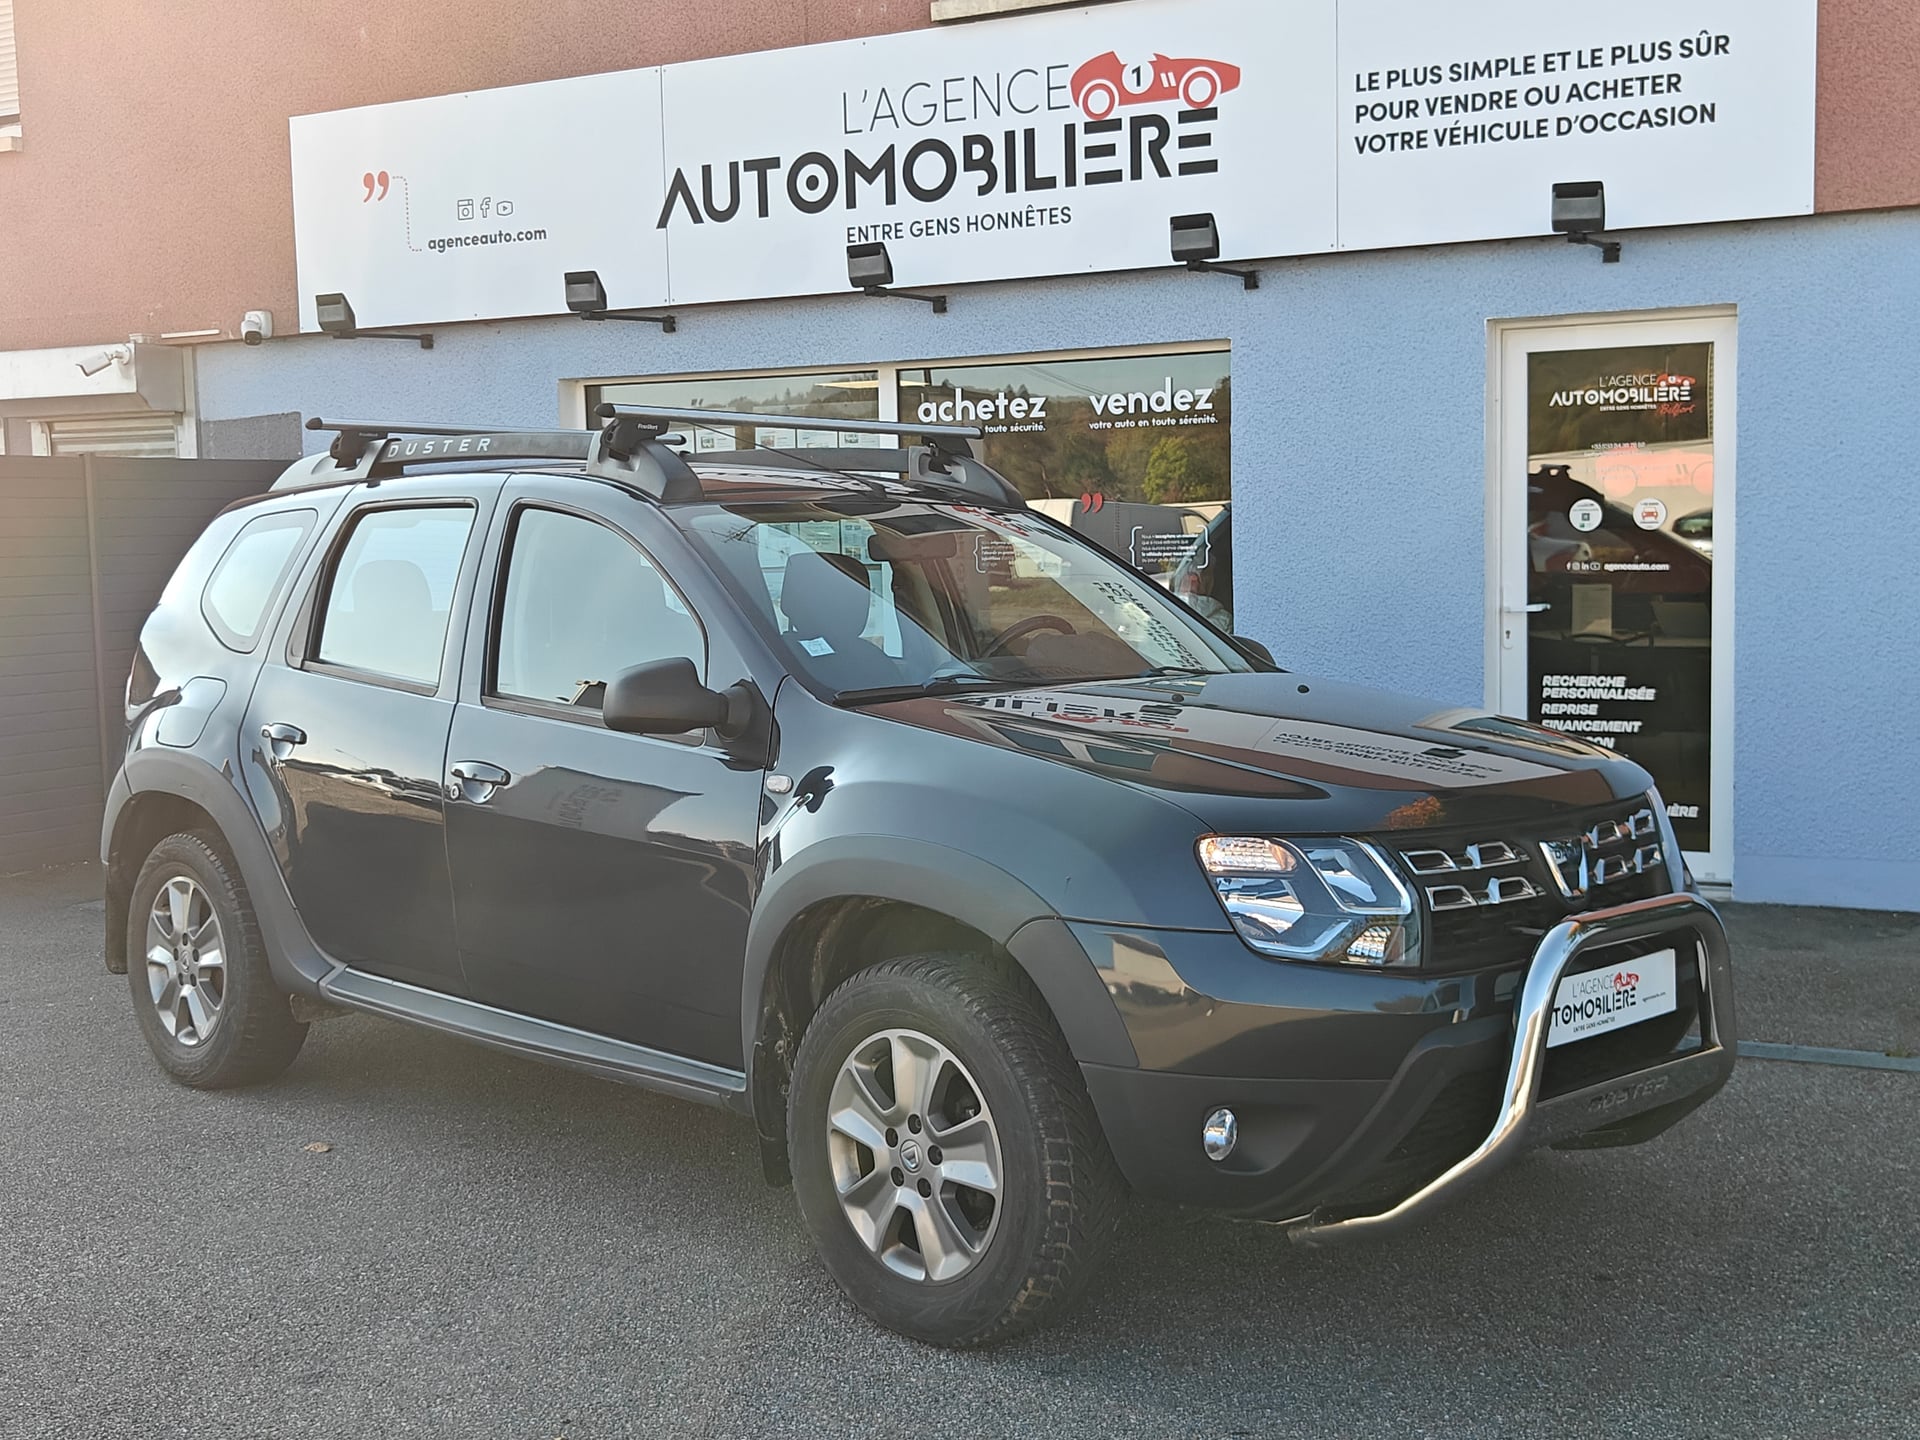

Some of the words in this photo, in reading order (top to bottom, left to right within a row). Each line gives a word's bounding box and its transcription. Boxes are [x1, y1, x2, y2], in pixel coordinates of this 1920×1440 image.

[1355, 71, 1380, 92] LE
[1386, 65, 1442, 89] PLUS
[1449, 55, 1536, 83] SIMPLE
[1542, 51, 1571, 74] ET
[1577, 47, 1603, 70] LE
[1610, 40, 1672, 66] PLUS
[1678, 30, 1730, 58] SÛR
[842, 64, 1071, 135] L'AGENCE
[1355, 97, 1419, 123] POUR
[1425, 89, 1518, 116] VENDRE
[1524, 85, 1560, 106] OU
[1565, 73, 1682, 103] ACHETER
[1354, 129, 1428, 155] VOTRE
[1434, 118, 1549, 148] VÉHICULE
[1555, 102, 1716, 137] D'OCCASION
[847, 219, 904, 243] ENTRE
[909, 217, 961, 237] GENS
[966, 205, 1072, 232] HONNÊTES
[427, 226, 547, 253] agenceauto.com
[1600, 374, 1656, 388] L'AGENCE
[918, 388, 1047, 424] achetez
[1088, 377, 1213, 416] vendez
[985, 424, 1008, 434] toute
[1010, 422, 1046, 433] sécurité.
[1089, 421, 1112, 431] votre
[1114, 420, 1136, 429] auto
[1138, 419, 1149, 428] en
[1152, 417, 1176, 427] toute
[1179, 414, 1218, 426] sérénité.
[387, 437, 491, 459] DUSTER
[1604, 562, 1670, 572] agenceauto.com
[1542, 675, 1627, 688] RECHERCHE
[1542, 686, 1657, 700] PERSONNALISÉE
[1541, 703, 1599, 715] REPRISE
[1541, 719, 1643, 733] FINANCEMENT
[1572, 973, 1614, 998] L'AGENCE
[1552, 986, 1637, 1028] TOMOBILIERE
